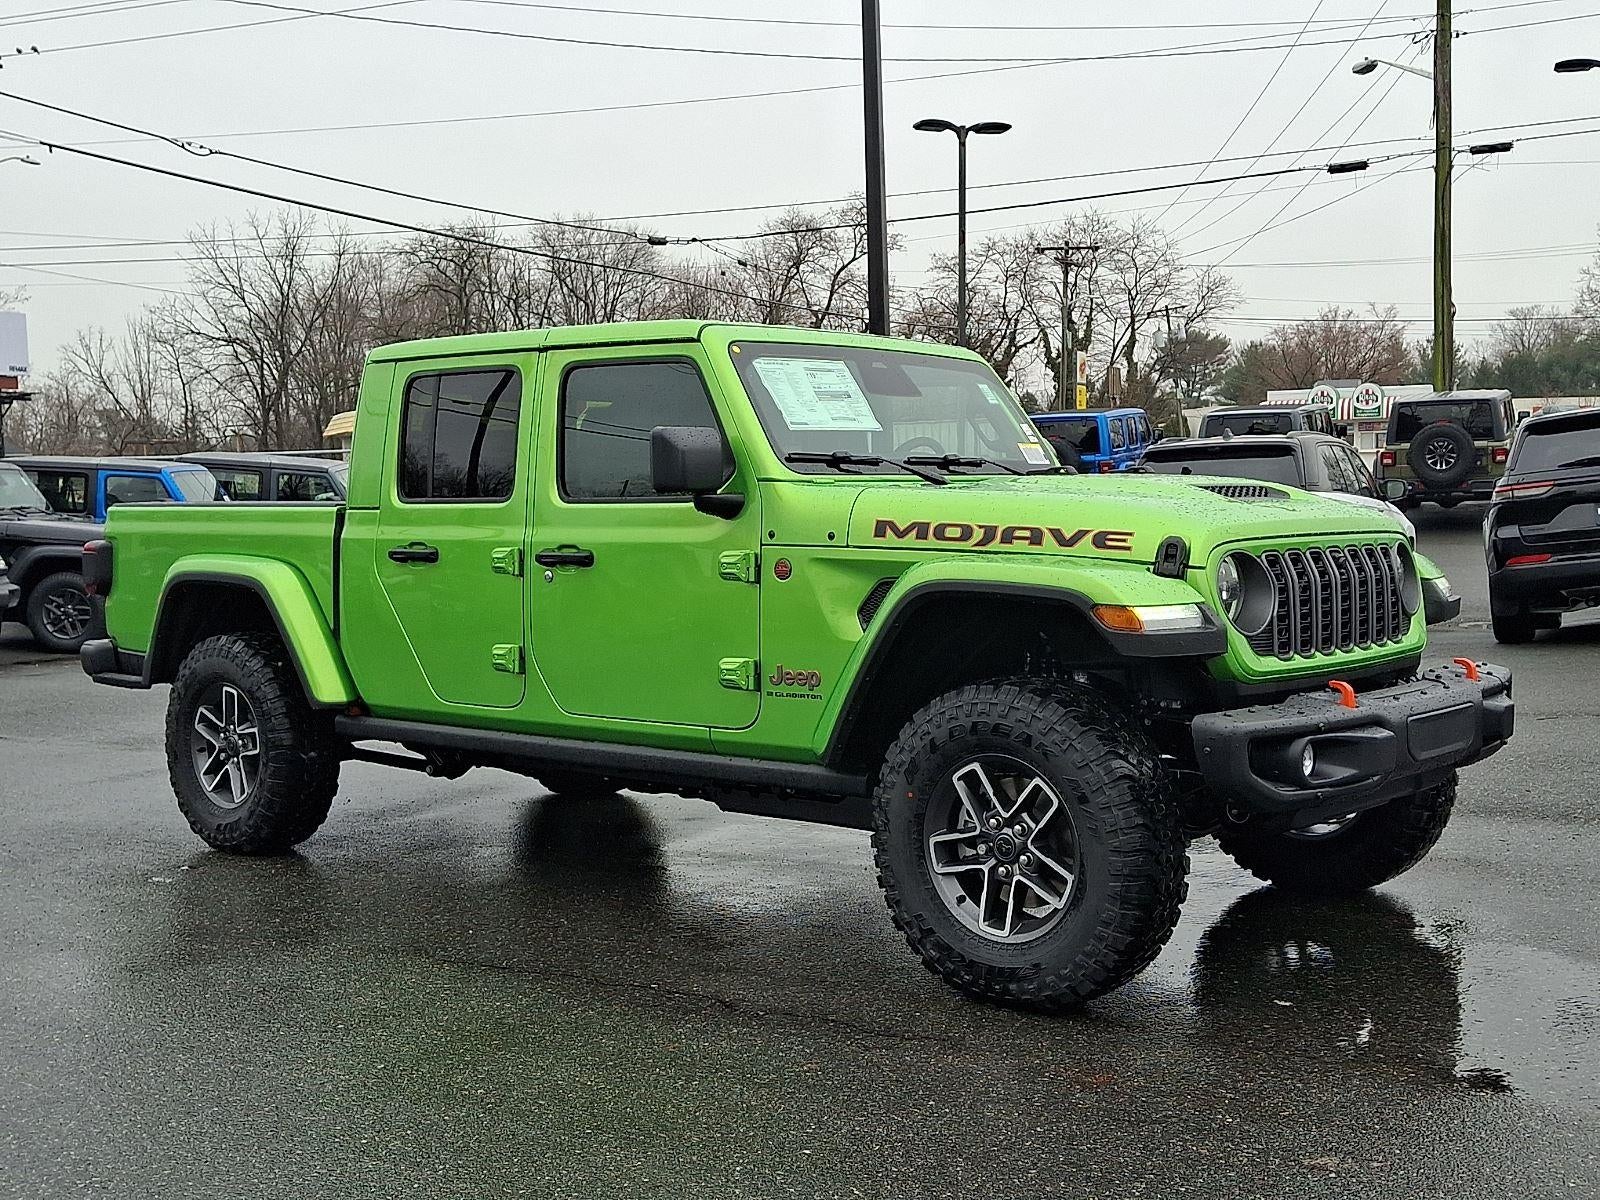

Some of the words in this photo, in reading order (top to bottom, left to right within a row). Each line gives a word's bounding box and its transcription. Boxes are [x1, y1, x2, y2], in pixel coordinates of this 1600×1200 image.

[873, 518, 1136, 553] MOJAVE
[768, 663, 822, 692] Jeep
[774, 691, 823, 701] GLADIATOR
